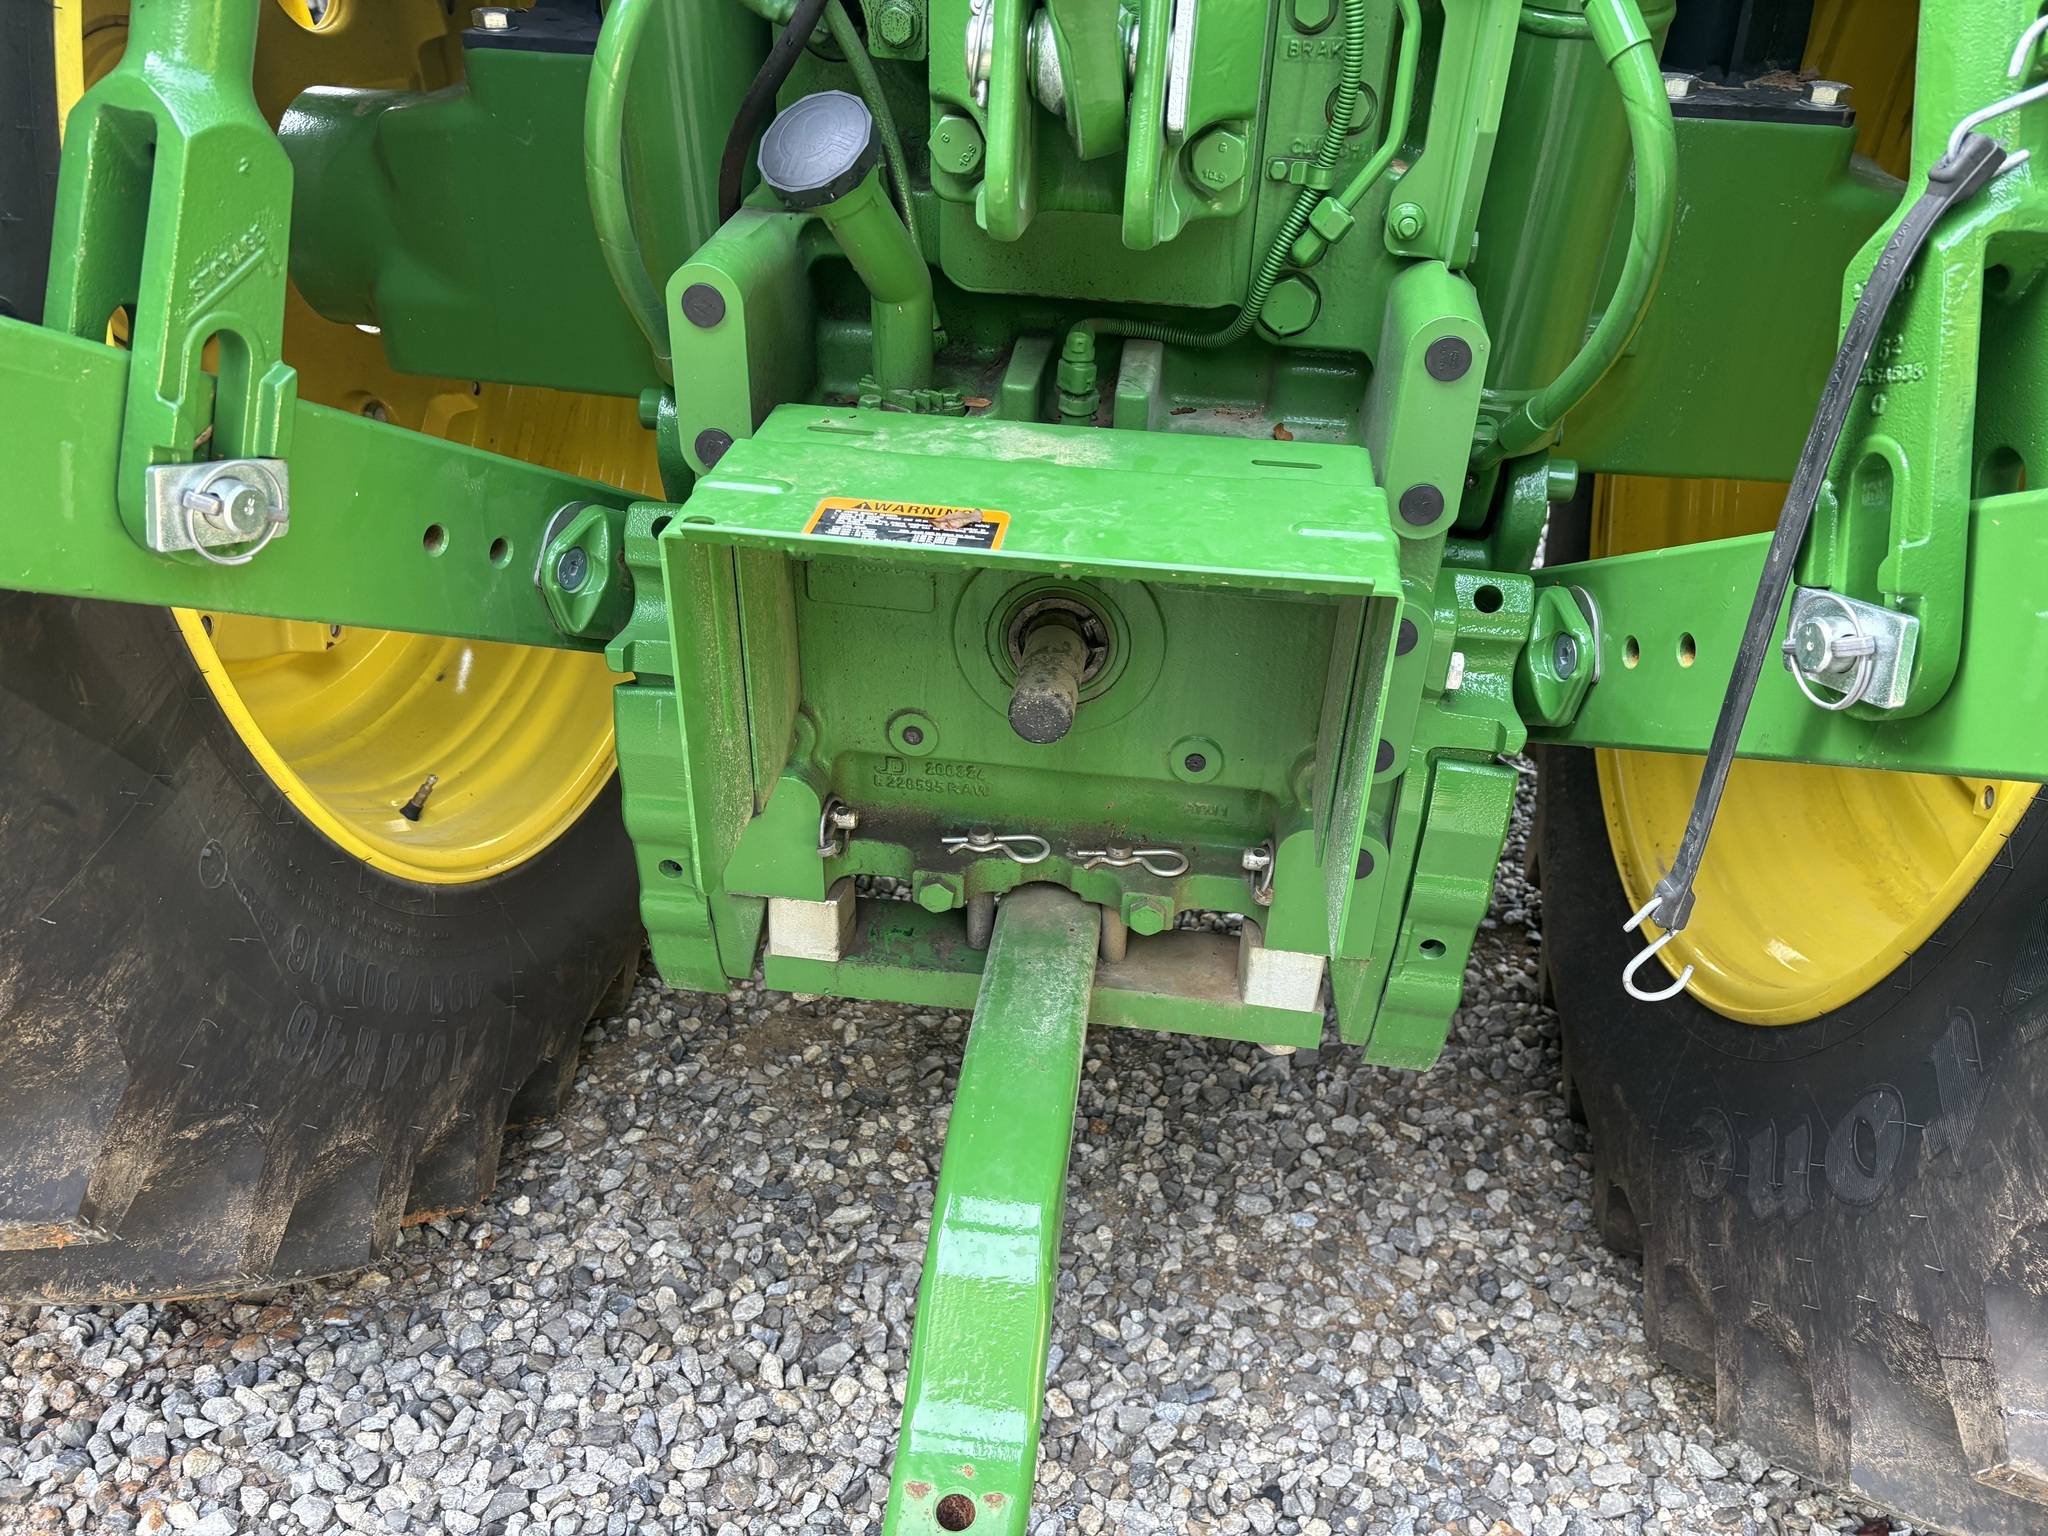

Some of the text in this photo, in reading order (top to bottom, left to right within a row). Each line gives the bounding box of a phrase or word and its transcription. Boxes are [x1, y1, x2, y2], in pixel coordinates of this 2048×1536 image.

[1287, 40, 1344, 57] BRAK
[188, 222, 266, 298] STORAGE
[875, 502, 972, 517] WARNIN
